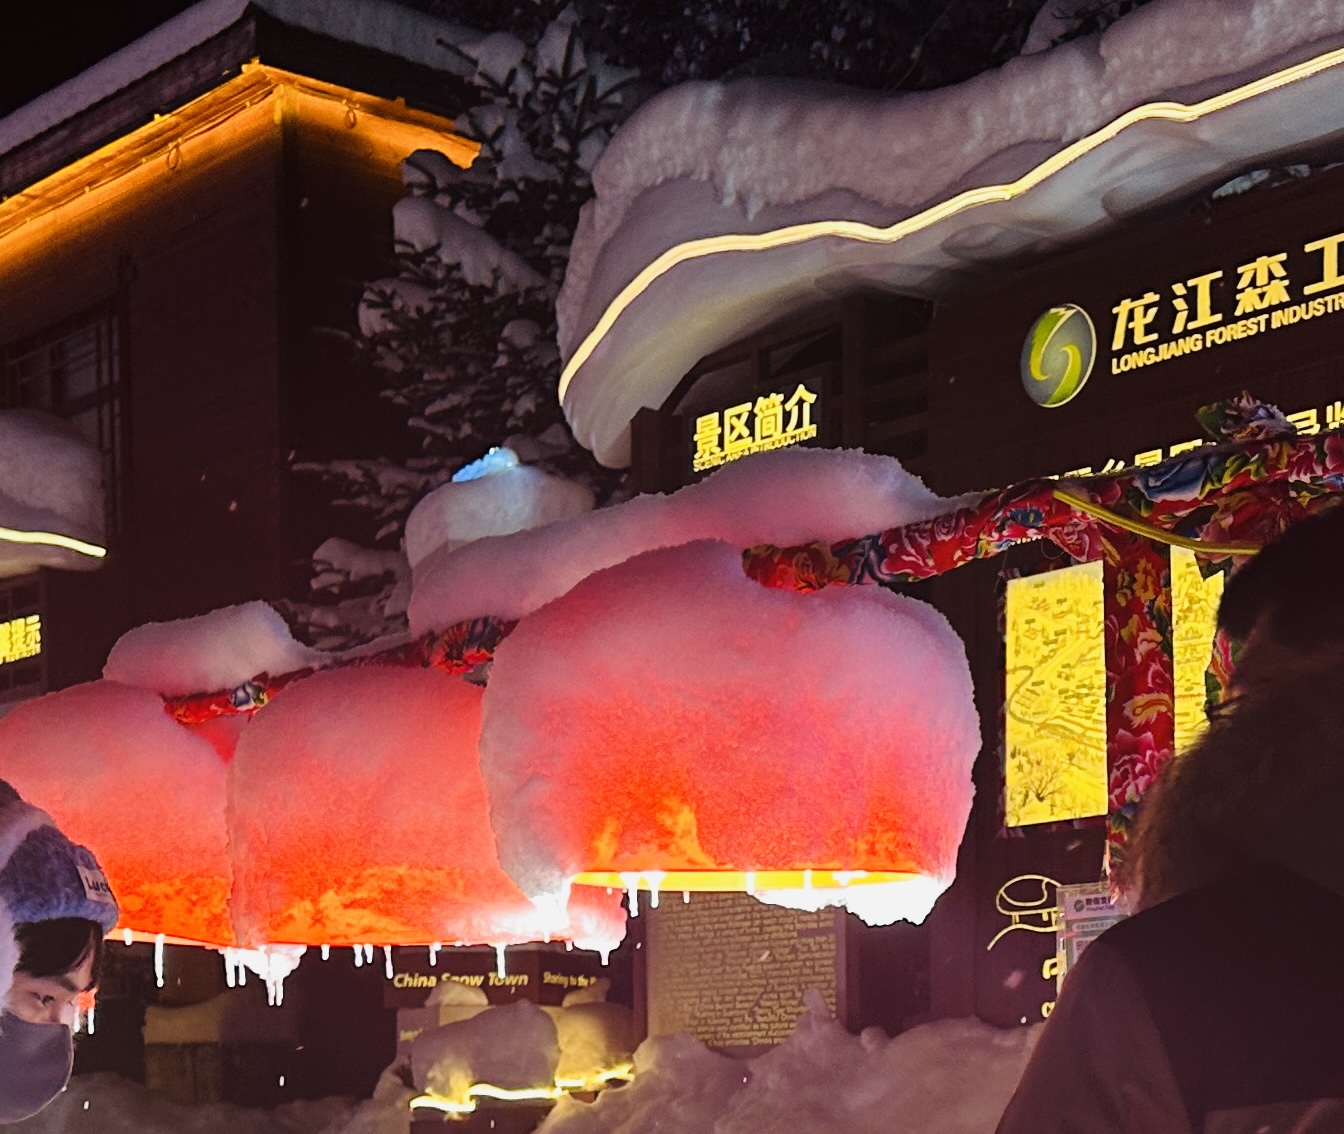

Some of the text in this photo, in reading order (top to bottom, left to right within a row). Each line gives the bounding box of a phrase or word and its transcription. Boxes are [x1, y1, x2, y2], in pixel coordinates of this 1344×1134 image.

[1111, 334, 1203, 375] LONGJIANG
[1206, 313, 1269, 348] FOREST
[693, 383, 817, 460] 景区简介
[393, 971, 437, 988] China
[488, 971, 529, 987] Town
